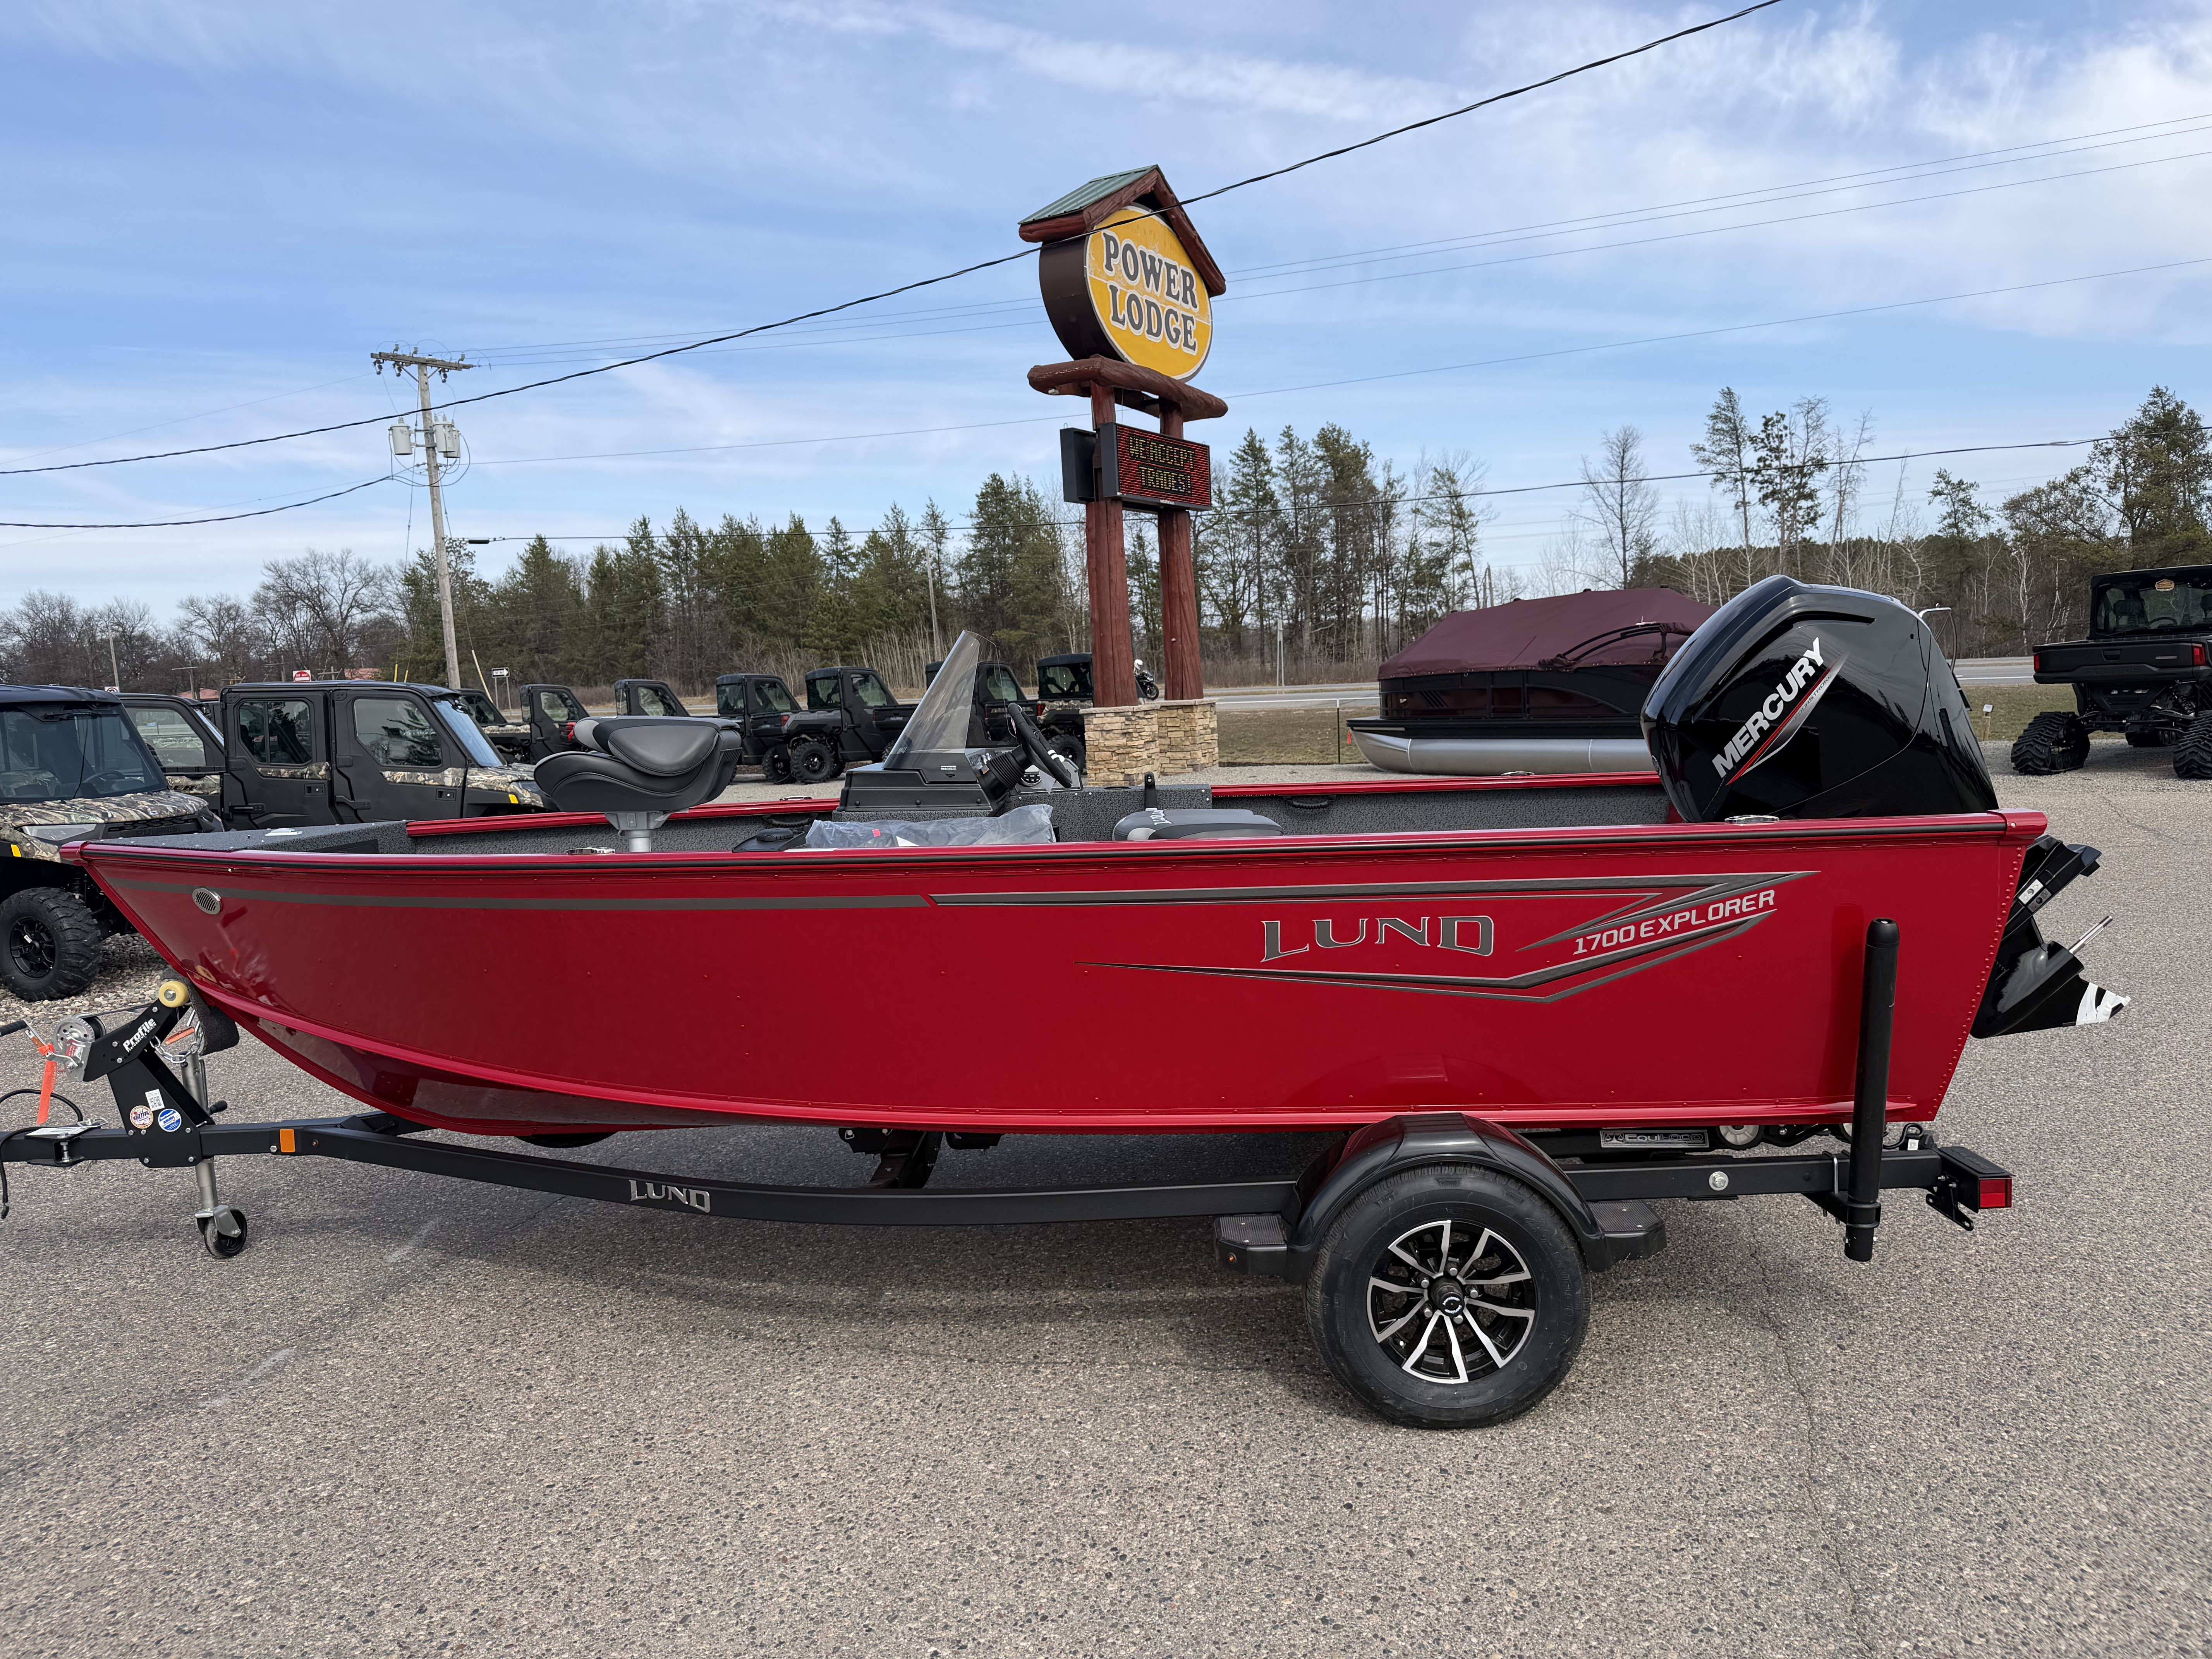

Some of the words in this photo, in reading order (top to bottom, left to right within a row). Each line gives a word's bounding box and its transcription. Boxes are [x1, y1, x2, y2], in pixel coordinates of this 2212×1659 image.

[1103, 232, 1198, 309] POWER
[1109, 284, 1197, 352] LODGE
[1129, 436, 1146, 459] WE
[1149, 442, 1195, 469] ACCEPT
[1139, 466, 1191, 493] TRADES!
[1712, 637, 1824, 778] MERCURY
[1793, 674, 1832, 720] FOURSTROKE
[1260, 915, 1494, 963] LUND
[1573, 925, 1635, 955] 1700
[1640, 890, 1775, 938] EXPLORER
[122, 1018, 156, 1051] Profile
[629, 1180, 711, 1213] LUND
